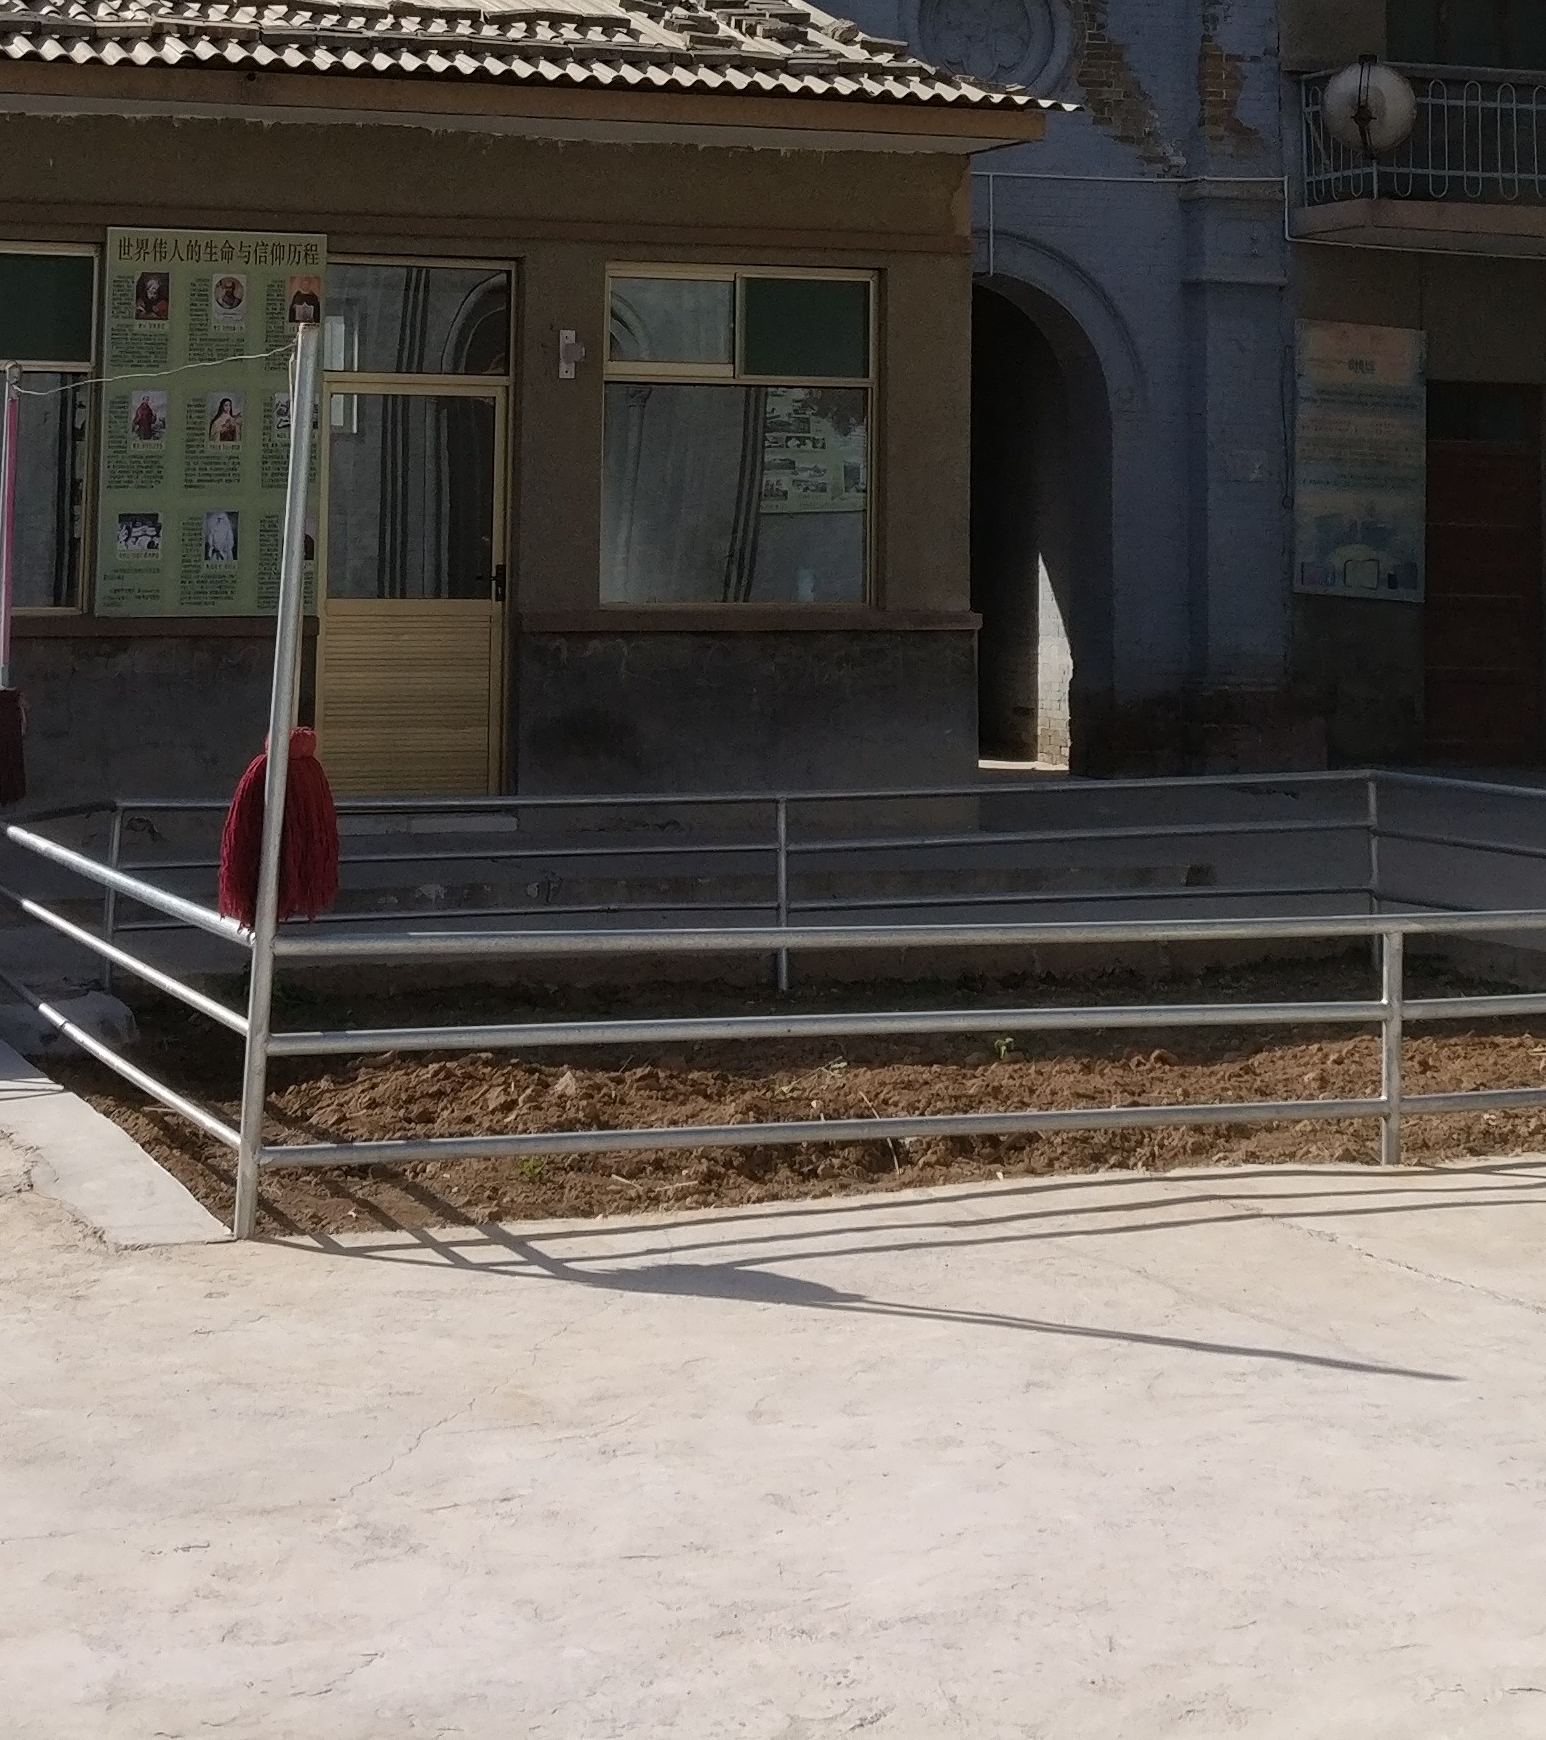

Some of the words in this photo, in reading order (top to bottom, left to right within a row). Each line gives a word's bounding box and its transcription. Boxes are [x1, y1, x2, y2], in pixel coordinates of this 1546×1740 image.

[117, 236, 320, 266] 世界伟人的生命与信仰历程
